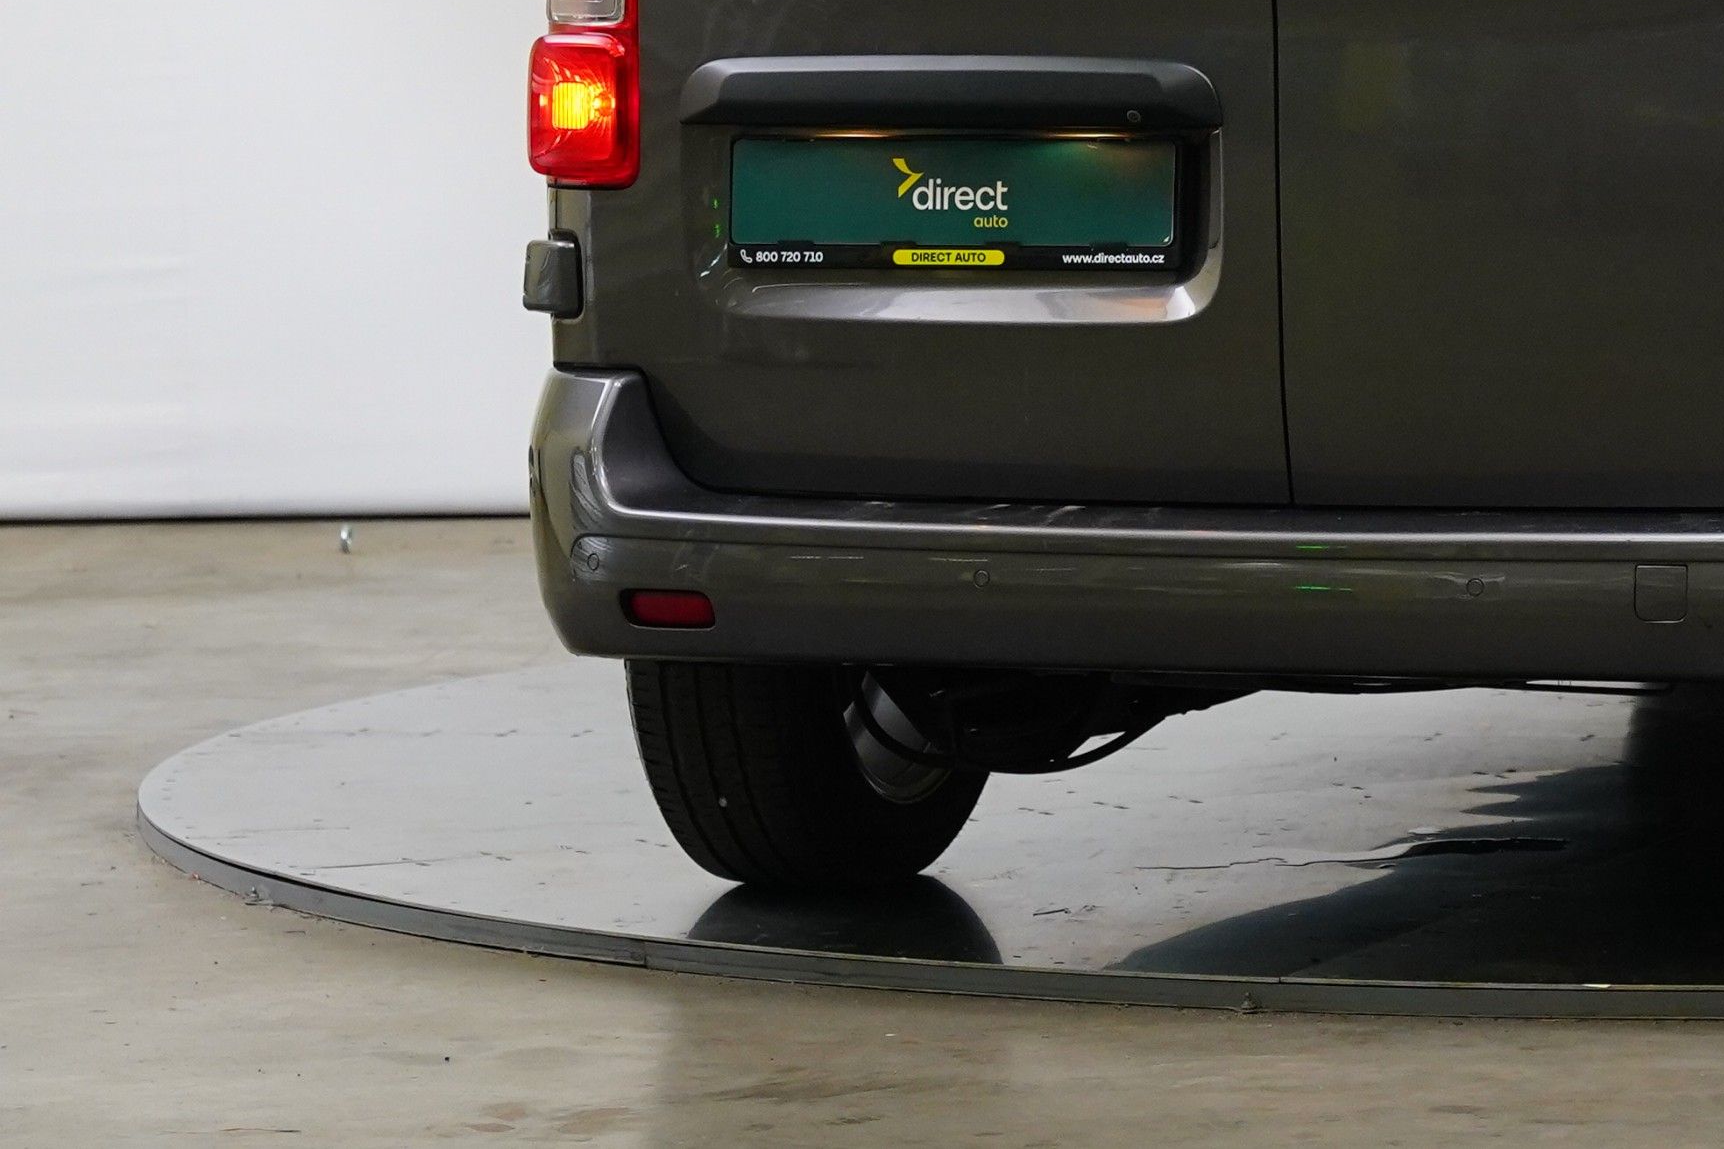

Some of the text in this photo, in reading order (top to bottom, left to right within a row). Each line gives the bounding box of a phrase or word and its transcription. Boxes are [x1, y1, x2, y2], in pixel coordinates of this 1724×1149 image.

[912, 177, 1009, 210] direct
[973, 215, 1009, 228] auto
[755, 251, 824, 263] 800 720 710
[911, 252, 987, 263] DIRECT AUTO
[1062, 252, 1165, 264] www.directauto.cz
